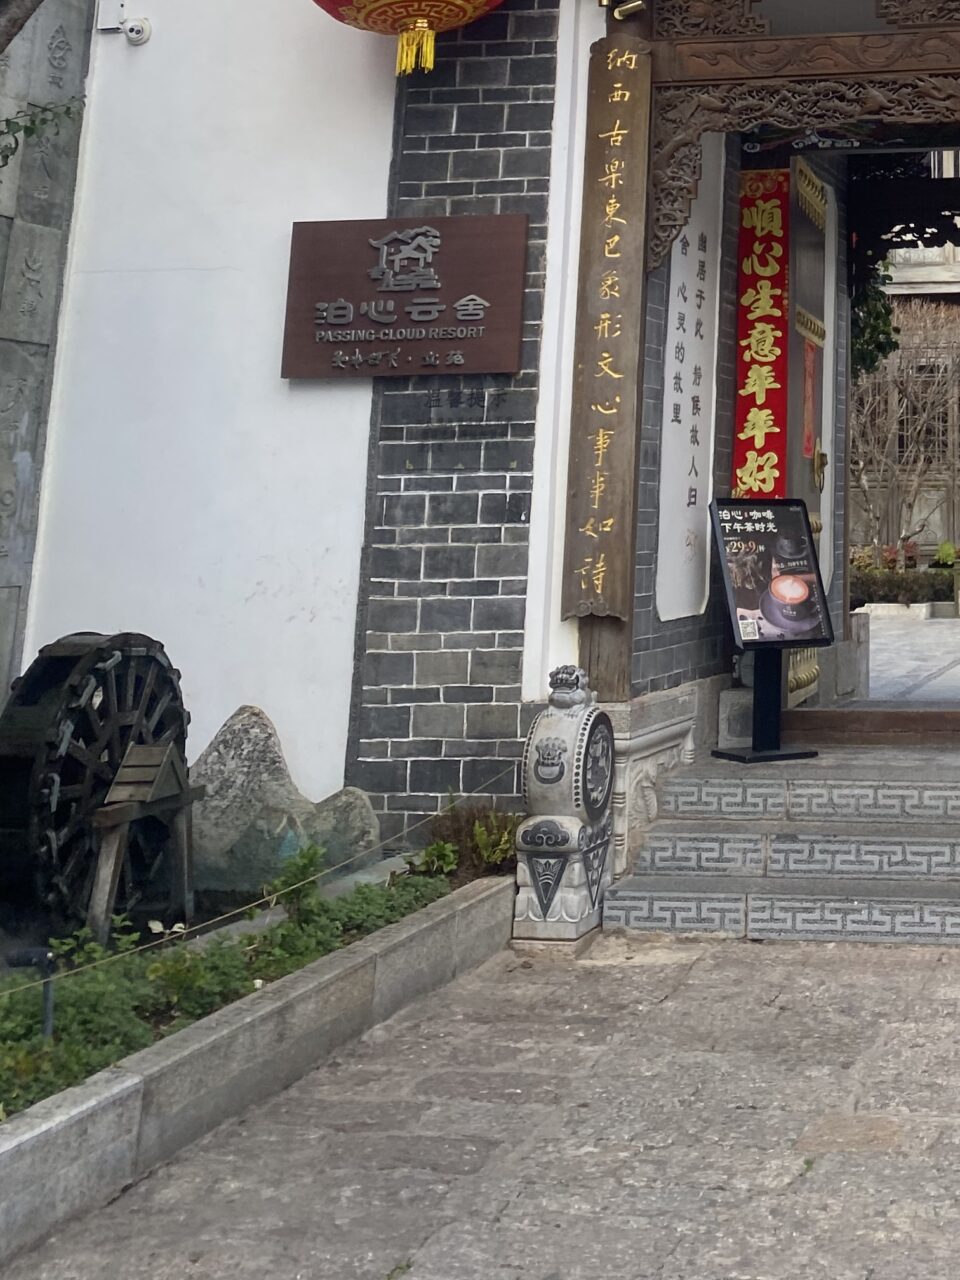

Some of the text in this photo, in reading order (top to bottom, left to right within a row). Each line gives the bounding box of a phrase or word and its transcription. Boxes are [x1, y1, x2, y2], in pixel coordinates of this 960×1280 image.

[314, 294, 490, 325] 泊心云舍
[315, 325, 485, 342] PASSING-CLOUD RESORT
[736, 200, 784, 493] 順心生意年年好
[720, 522, 777, 532] 下午茶时光
